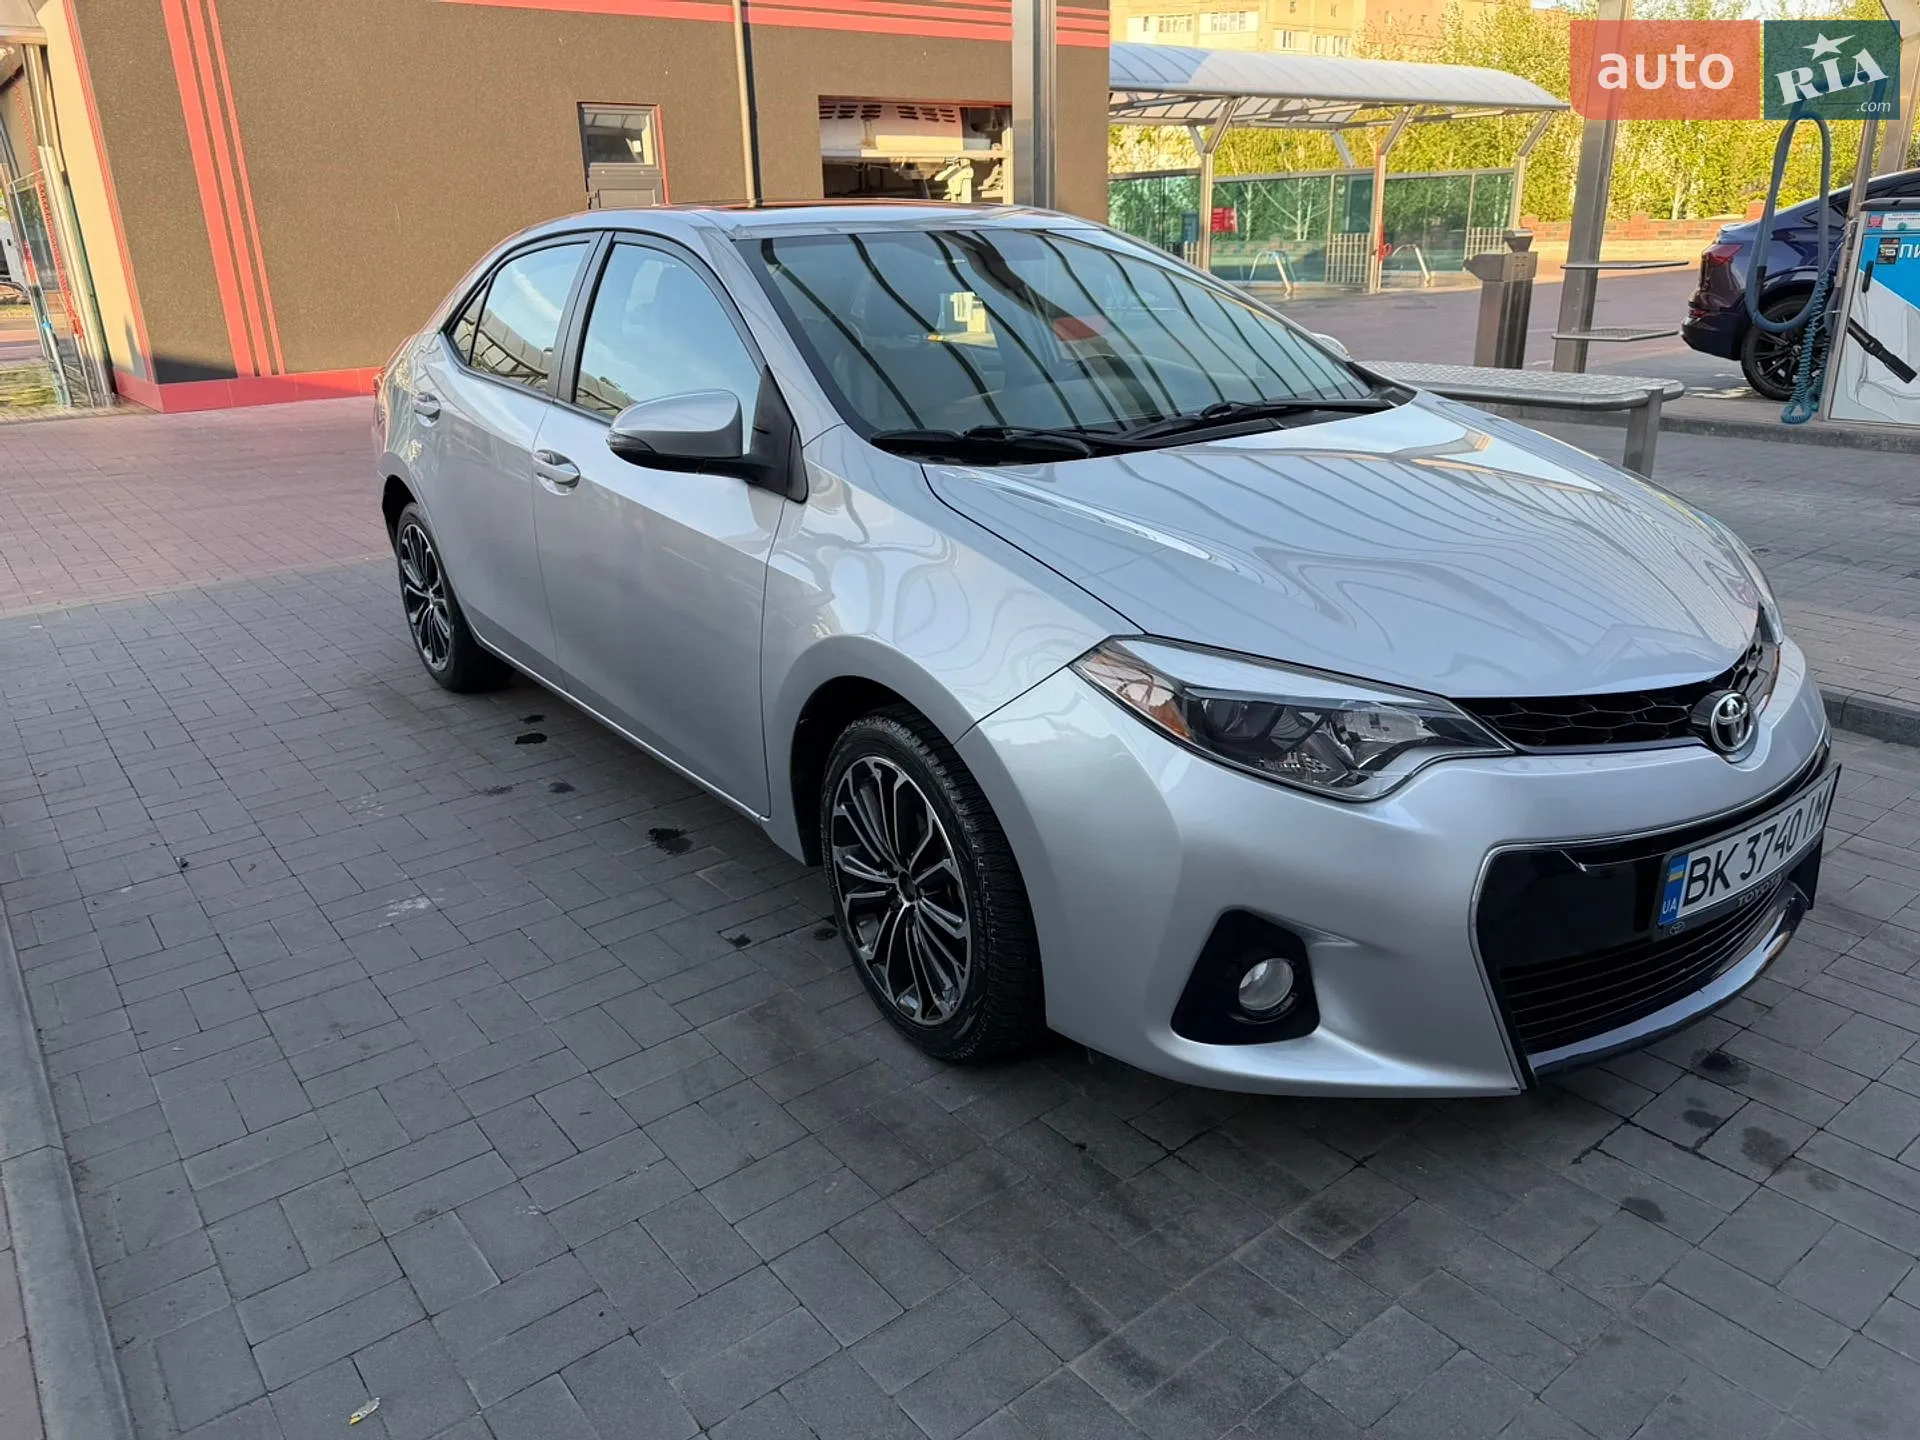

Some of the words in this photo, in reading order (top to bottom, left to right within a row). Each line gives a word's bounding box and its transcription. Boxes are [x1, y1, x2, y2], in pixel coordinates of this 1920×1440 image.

[1682, 843, 1740, 907] BK
[1740, 808, 1802, 880] 3740
[1662, 897, 1677, 914] UA
